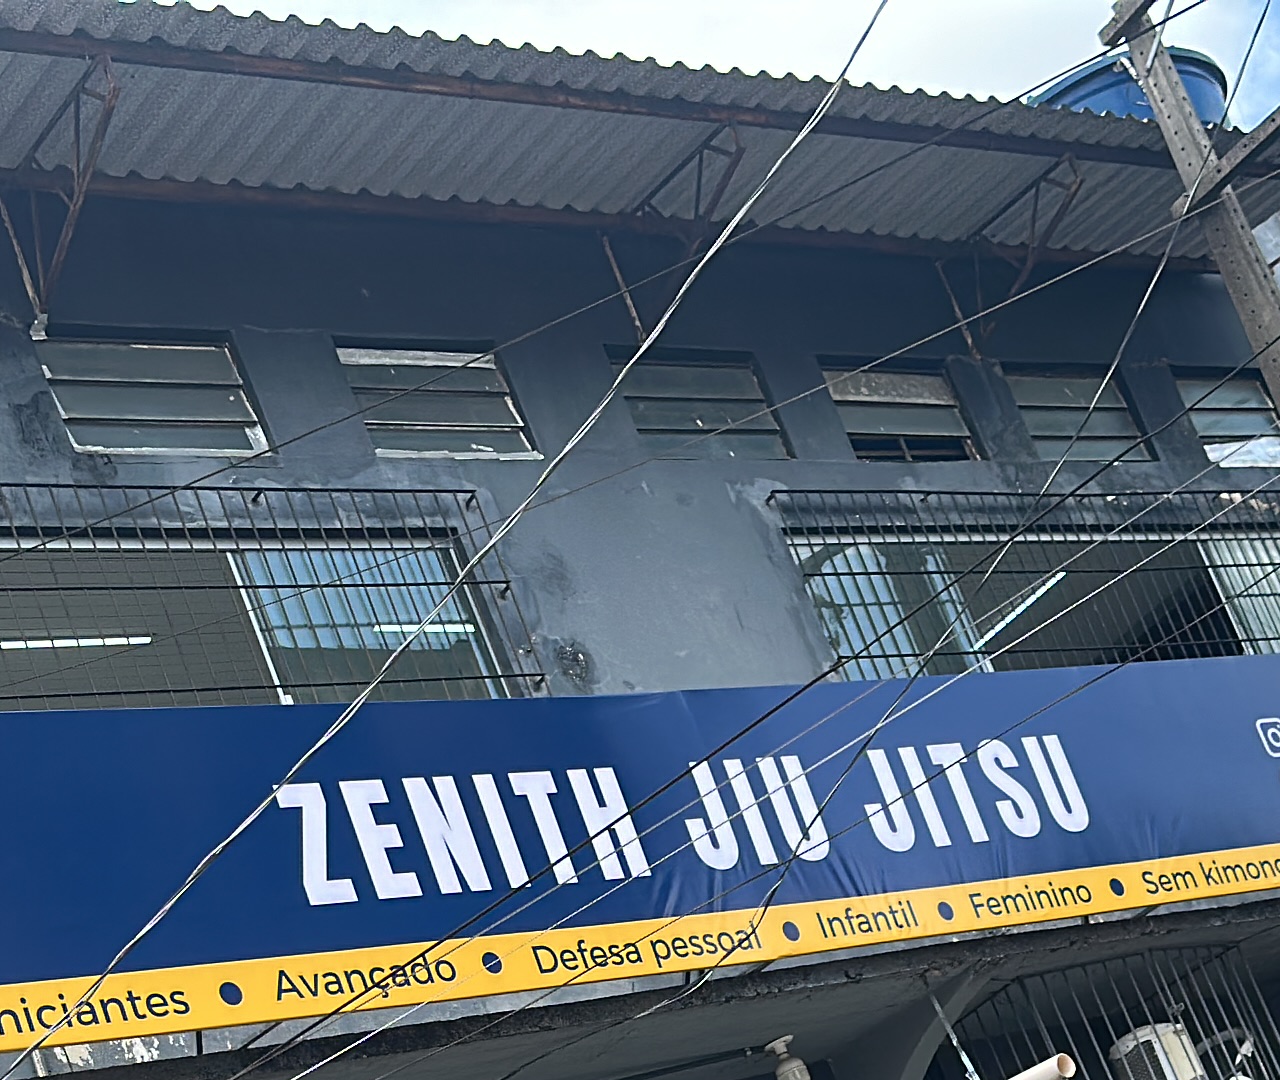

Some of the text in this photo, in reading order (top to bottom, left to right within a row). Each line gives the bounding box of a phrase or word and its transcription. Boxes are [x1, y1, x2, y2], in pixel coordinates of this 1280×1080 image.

[273, 733, 1092, 907] ZENITH JIU JITSU
[274, 952, 458, 1003] Avançado
[531, 935, 643, 977] Defesa
[650, 921, 763, 971] pessoal
[816, 900, 918, 940] Infantil
[970, 881, 1093, 921] Feminino
[1141, 866, 1200, 896] Sem
